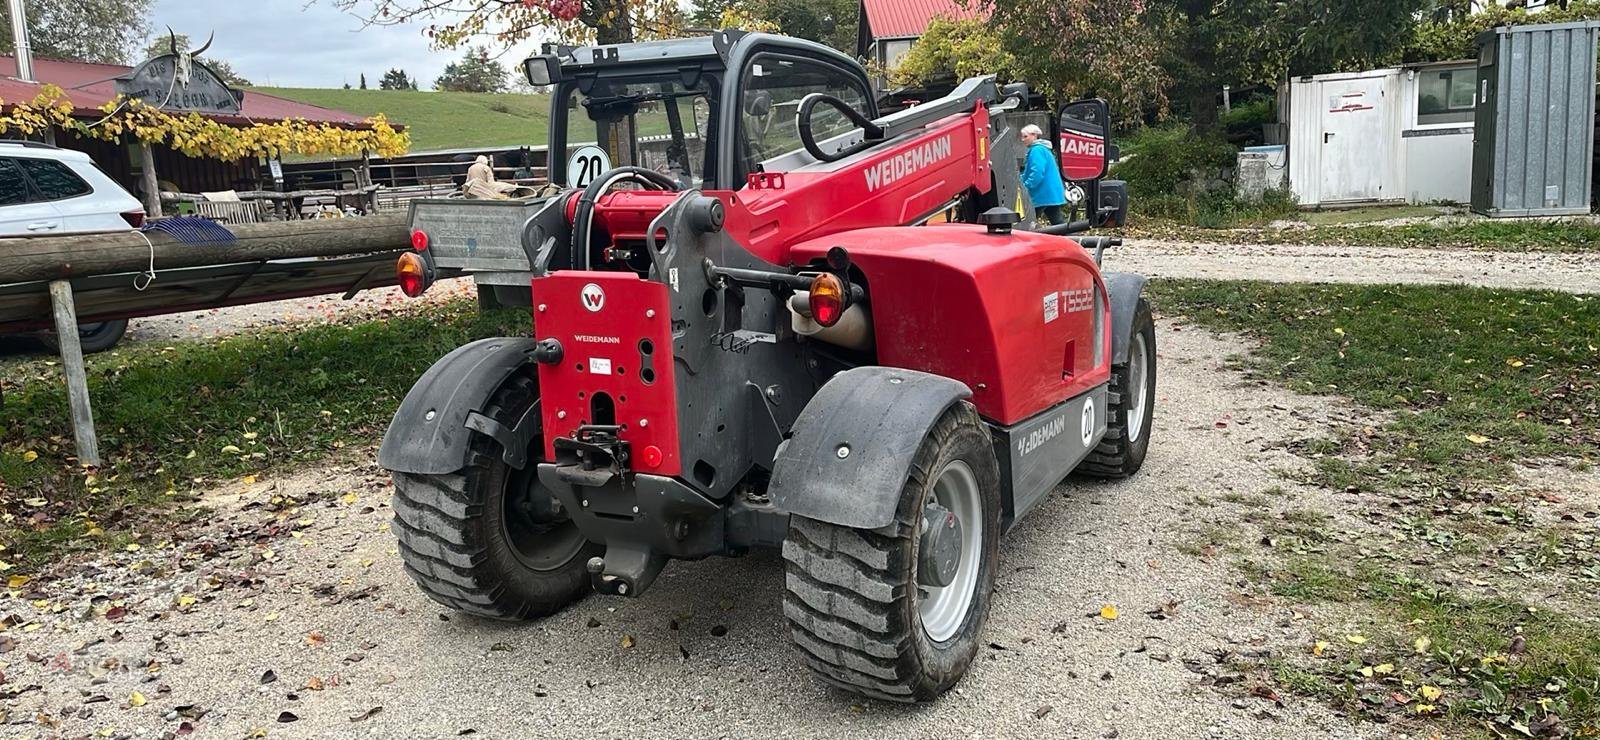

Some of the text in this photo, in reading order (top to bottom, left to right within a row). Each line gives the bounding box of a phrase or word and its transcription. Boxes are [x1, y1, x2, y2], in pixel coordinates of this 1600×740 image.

[576, 155, 602, 189] 20
[863, 134, 952, 193] WEIDEMANN
[574, 334, 621, 345] WEIDEMANN
[1083, 405, 1092, 439] 20
